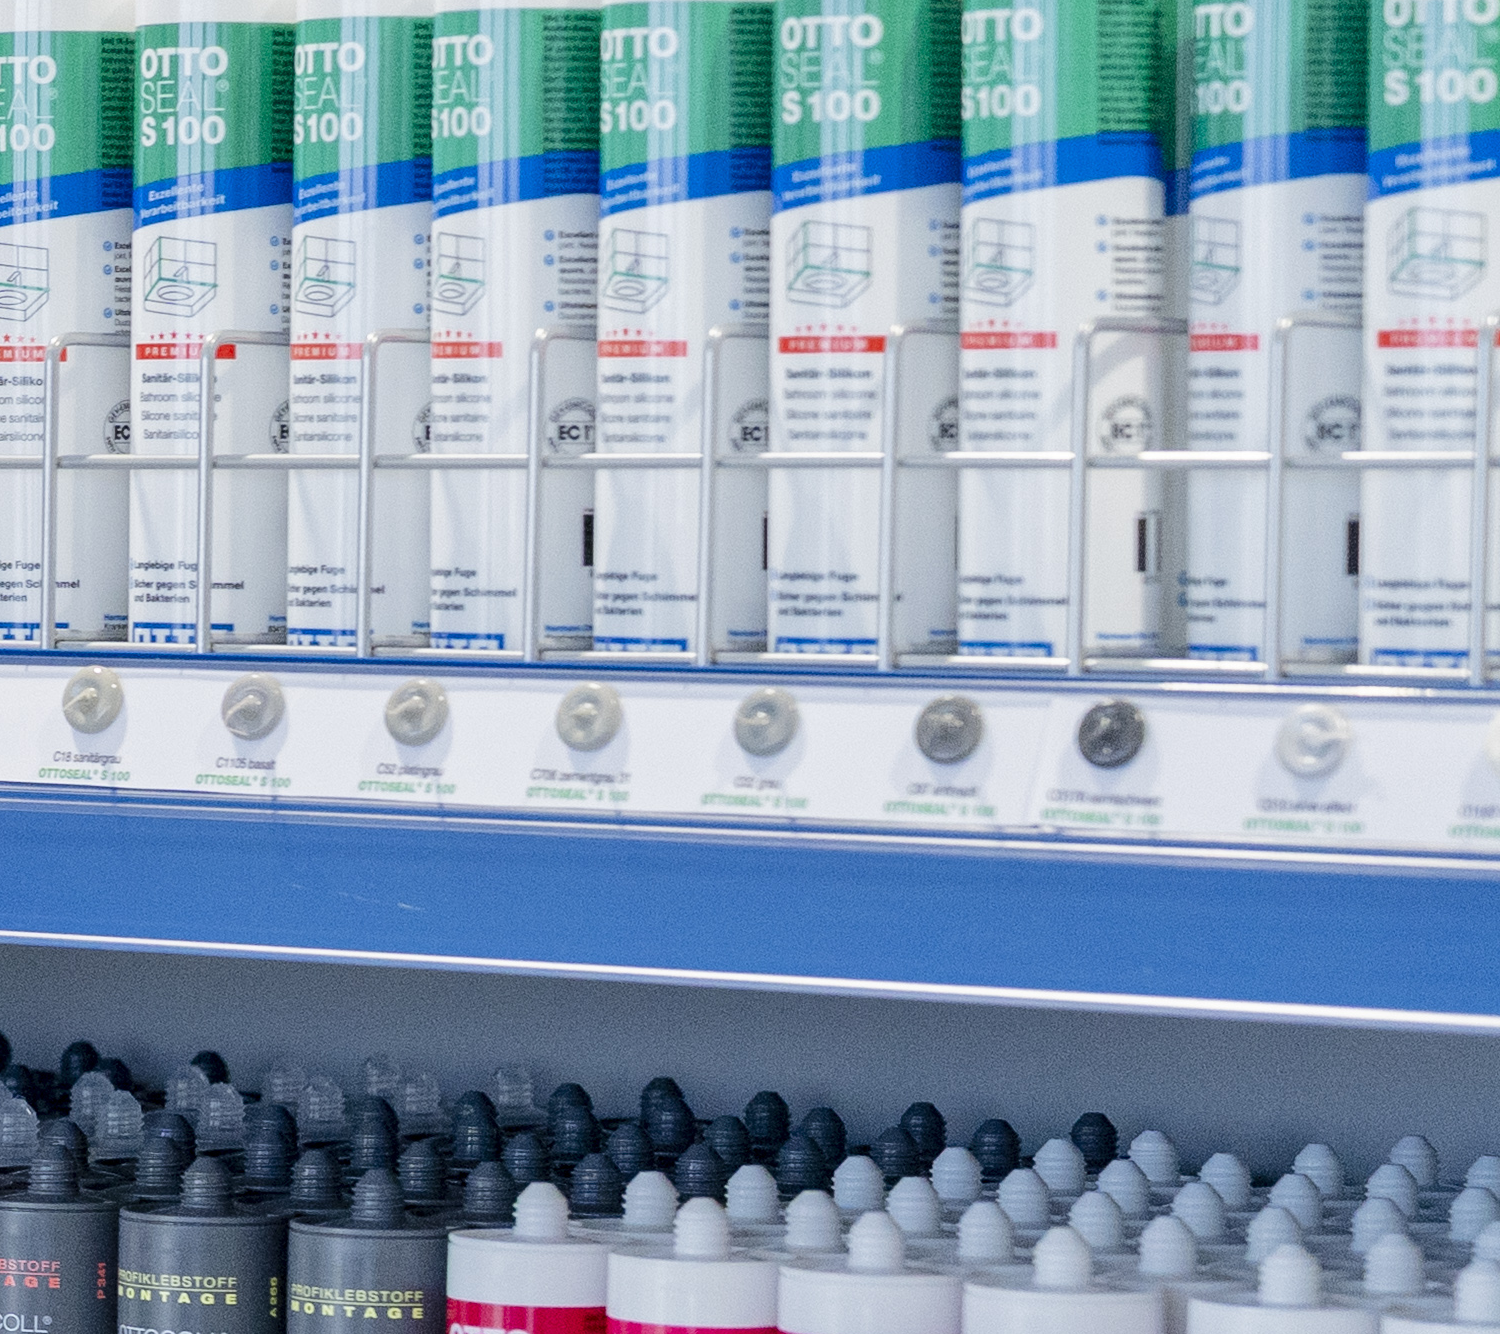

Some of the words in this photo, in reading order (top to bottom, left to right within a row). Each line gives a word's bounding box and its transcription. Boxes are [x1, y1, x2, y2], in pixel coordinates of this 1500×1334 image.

[781, 14, 884, 50] OTTO
[140, 46, 229, 79] OTTO
[141, 117, 157, 148] S
[160, 116, 227, 146] 100
[291, 1283, 424, 1302] PROFIKLEBSTOFF
